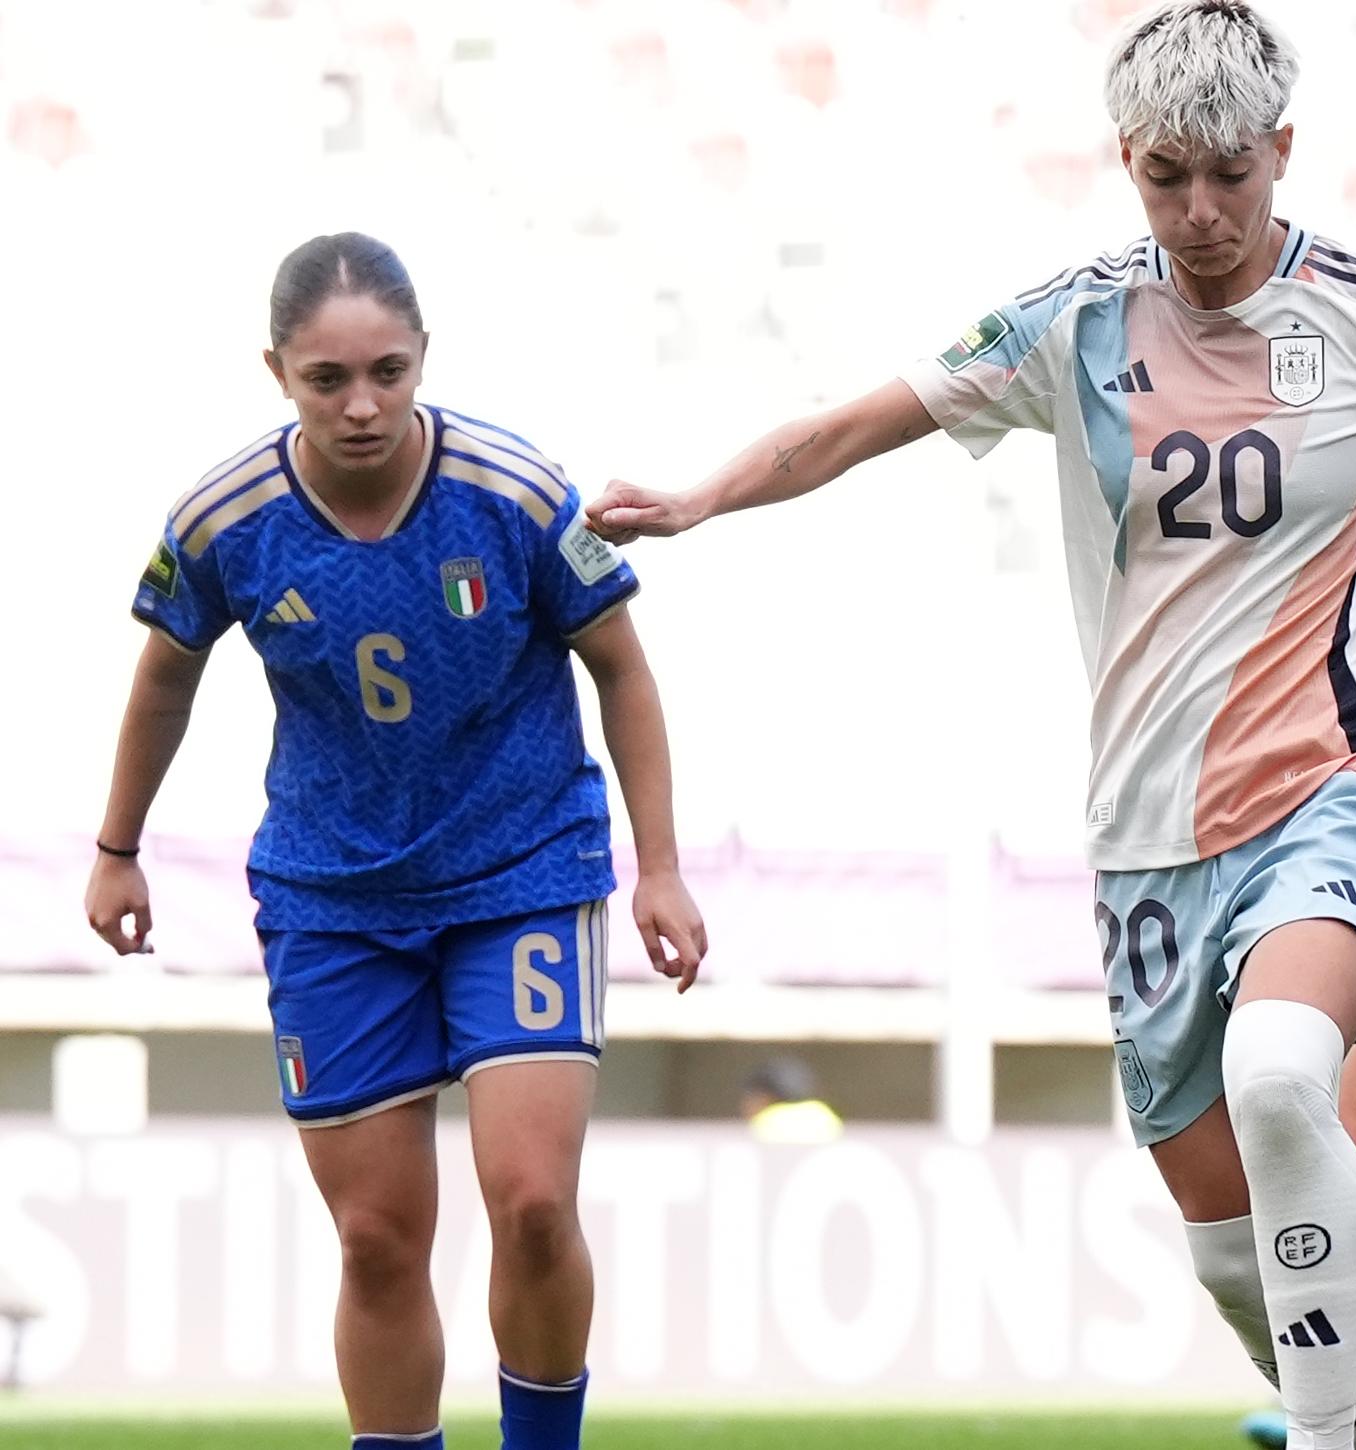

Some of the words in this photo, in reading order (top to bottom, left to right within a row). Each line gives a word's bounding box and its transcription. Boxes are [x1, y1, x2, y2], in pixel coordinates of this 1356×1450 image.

[1151, 428, 1283, 539] 20
[355, 633, 412, 723] 6
[512, 931, 565, 1031] 6
[0, 1136, 1197, 1384] STITIONS
[1284, 1232, 1316, 1247] RF
[1286, 1244, 1318, 1260] EF
